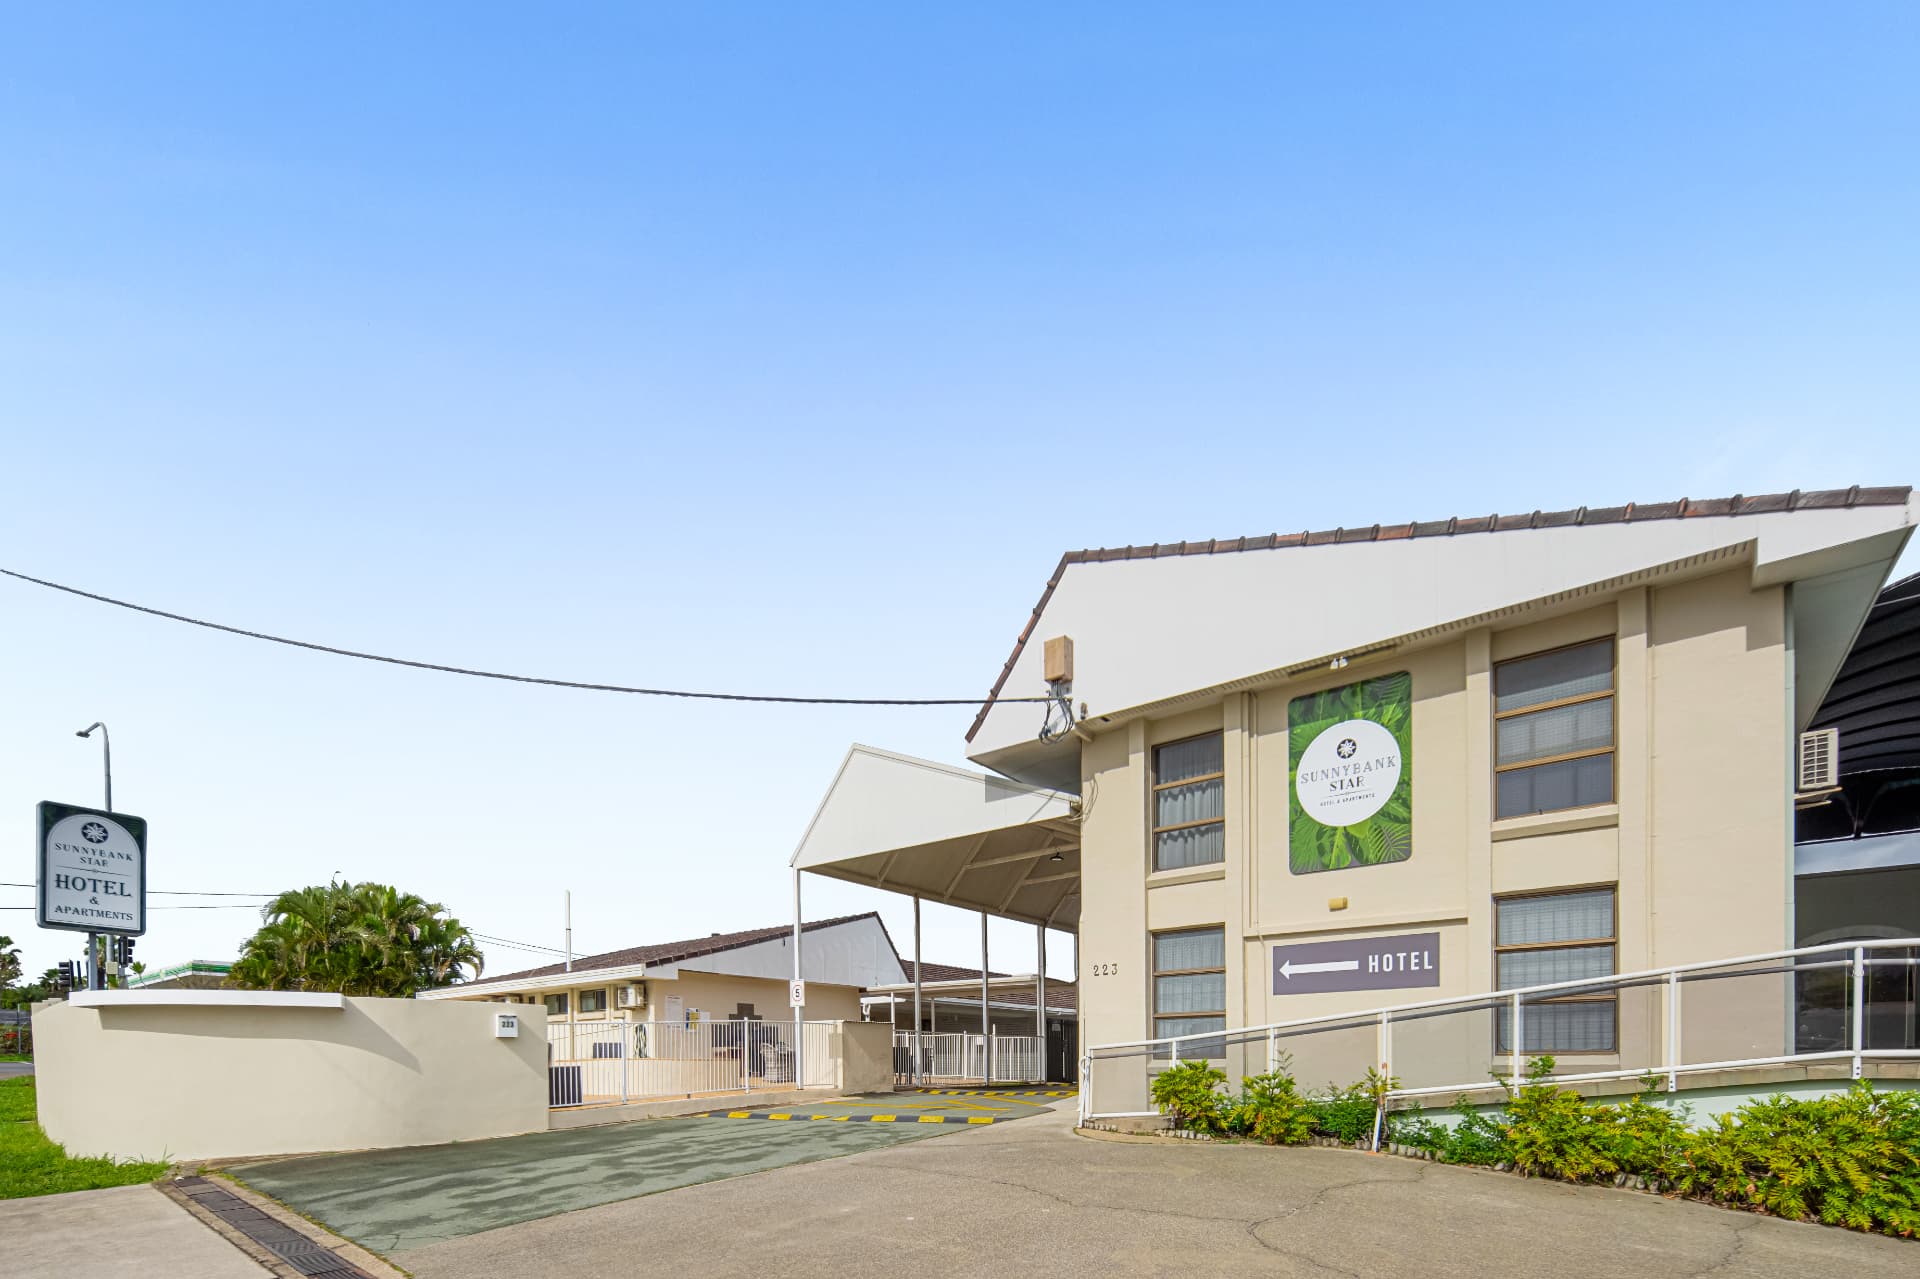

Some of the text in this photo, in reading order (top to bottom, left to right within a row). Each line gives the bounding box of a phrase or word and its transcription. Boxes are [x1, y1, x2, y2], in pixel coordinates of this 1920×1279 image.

[1300, 755, 1396, 784] SUNNYBANK
[1329, 776, 1366, 792] STAR
[55, 842, 133, 861] SUNNYBANK
[79, 856, 109, 867] STAR
[55, 873, 132, 897] HOTEL
[89, 896, 100, 905] &
[54, 905, 133, 920] APARTMENTS
[1368, 951, 1433, 973] HOTEL
[1093, 963, 1118, 977] 223
[795, 988, 800, 998] 5
[501, 1020, 515, 1028] 223
